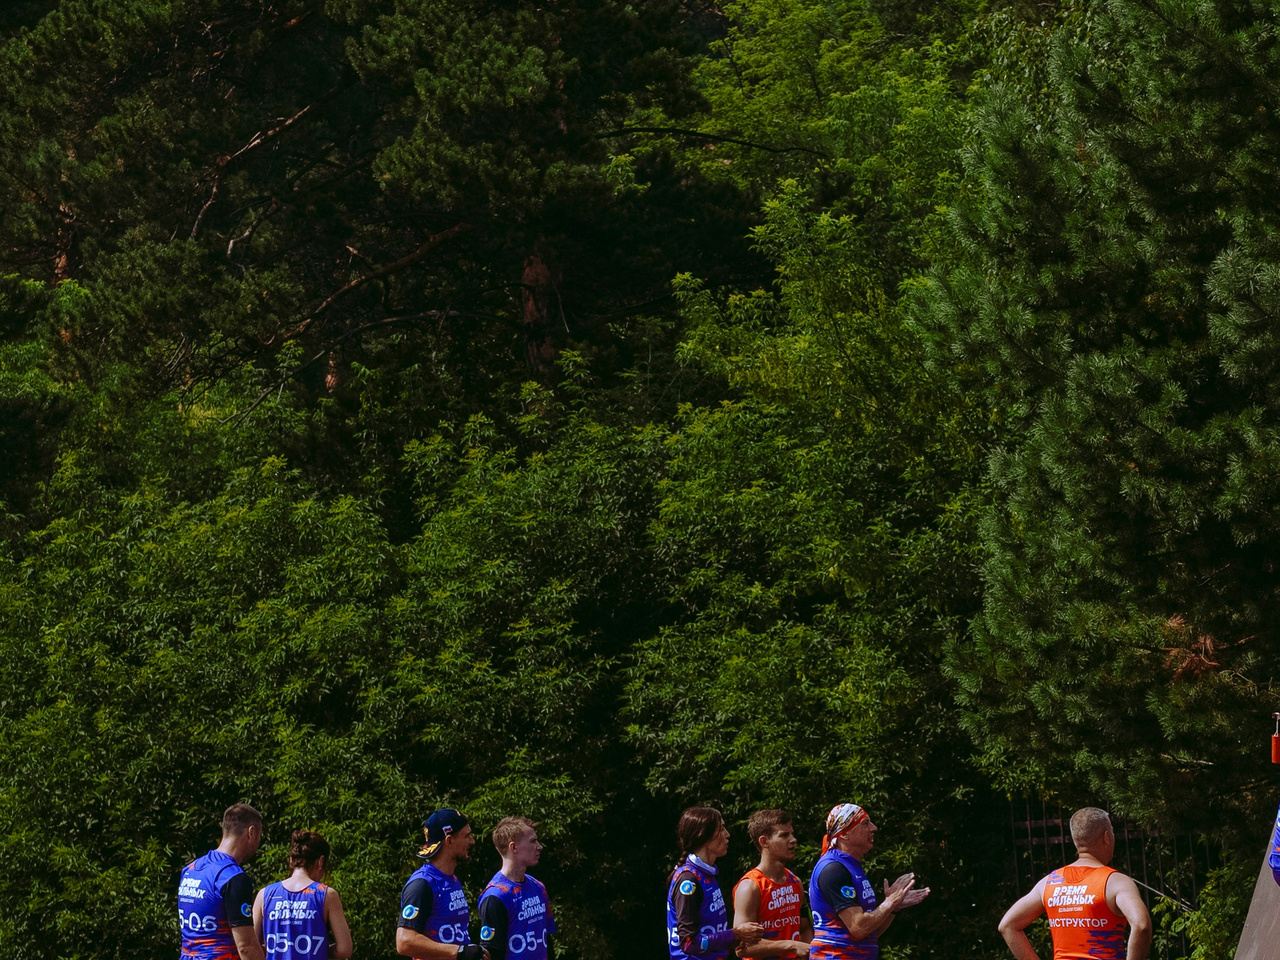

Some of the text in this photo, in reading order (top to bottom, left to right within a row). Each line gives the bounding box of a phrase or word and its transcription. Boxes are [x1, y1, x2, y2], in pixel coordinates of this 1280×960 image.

[771, 885, 794, 900] ВРЕМЯ
[1053, 885, 1088, 897] ВРЕМЯ
[1047, 894, 1096, 908] СИЛЬНЫХ
[269, 909, 317, 921] СИЛЬНЫХ
[266, 933, 325, 955] 05-07
